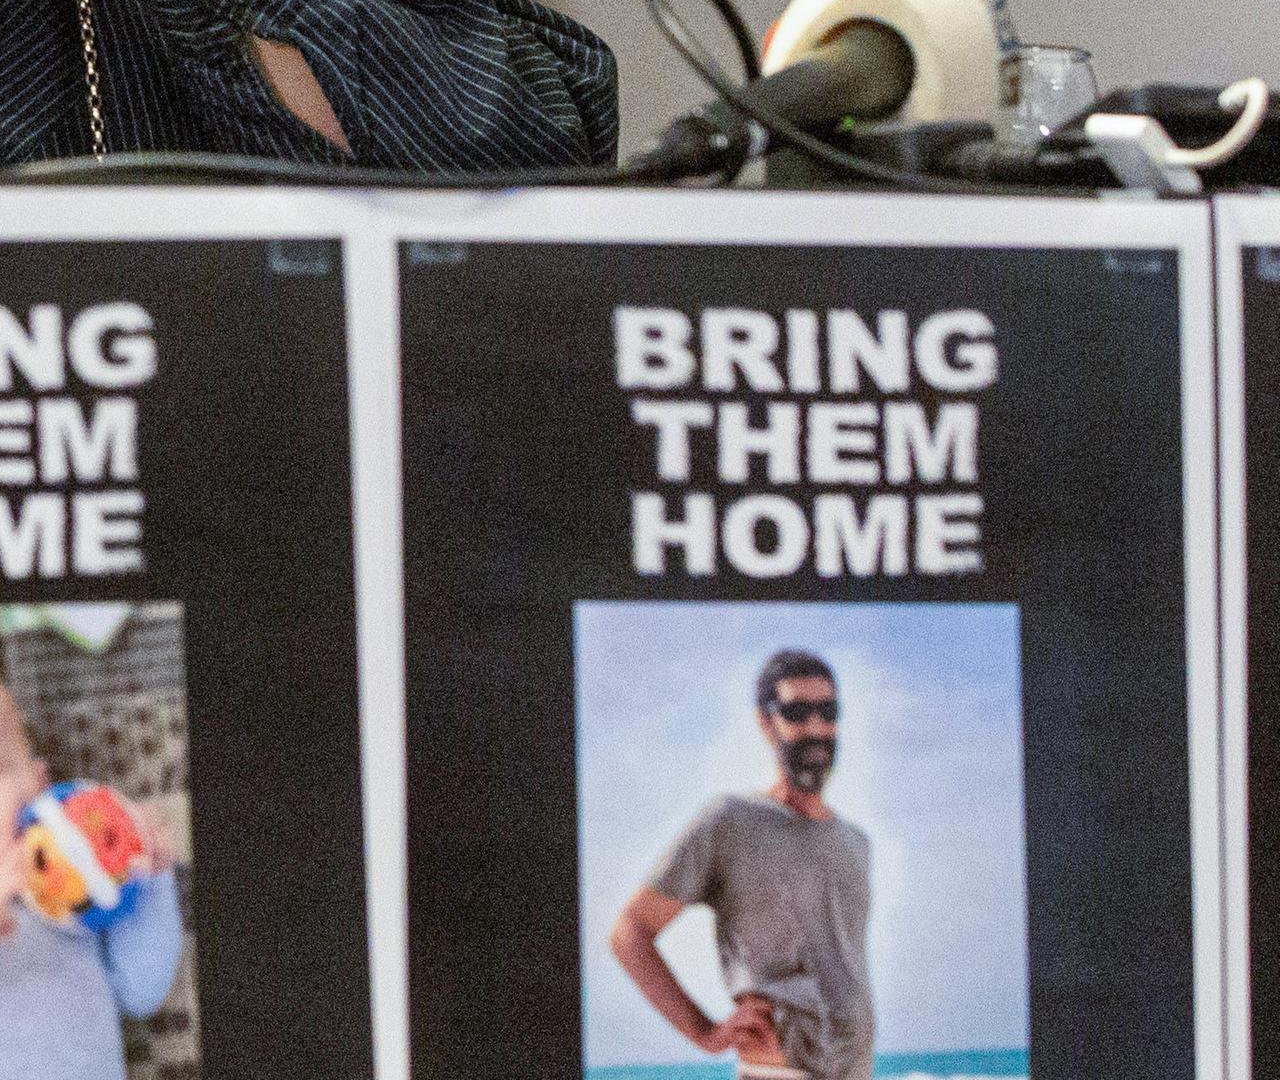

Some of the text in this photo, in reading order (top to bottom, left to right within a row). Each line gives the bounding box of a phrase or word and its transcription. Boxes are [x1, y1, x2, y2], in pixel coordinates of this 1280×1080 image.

[613, 306, 998, 394] BRING
[631, 399, 978, 484] THEM
[632, 492, 984, 578] HOME
